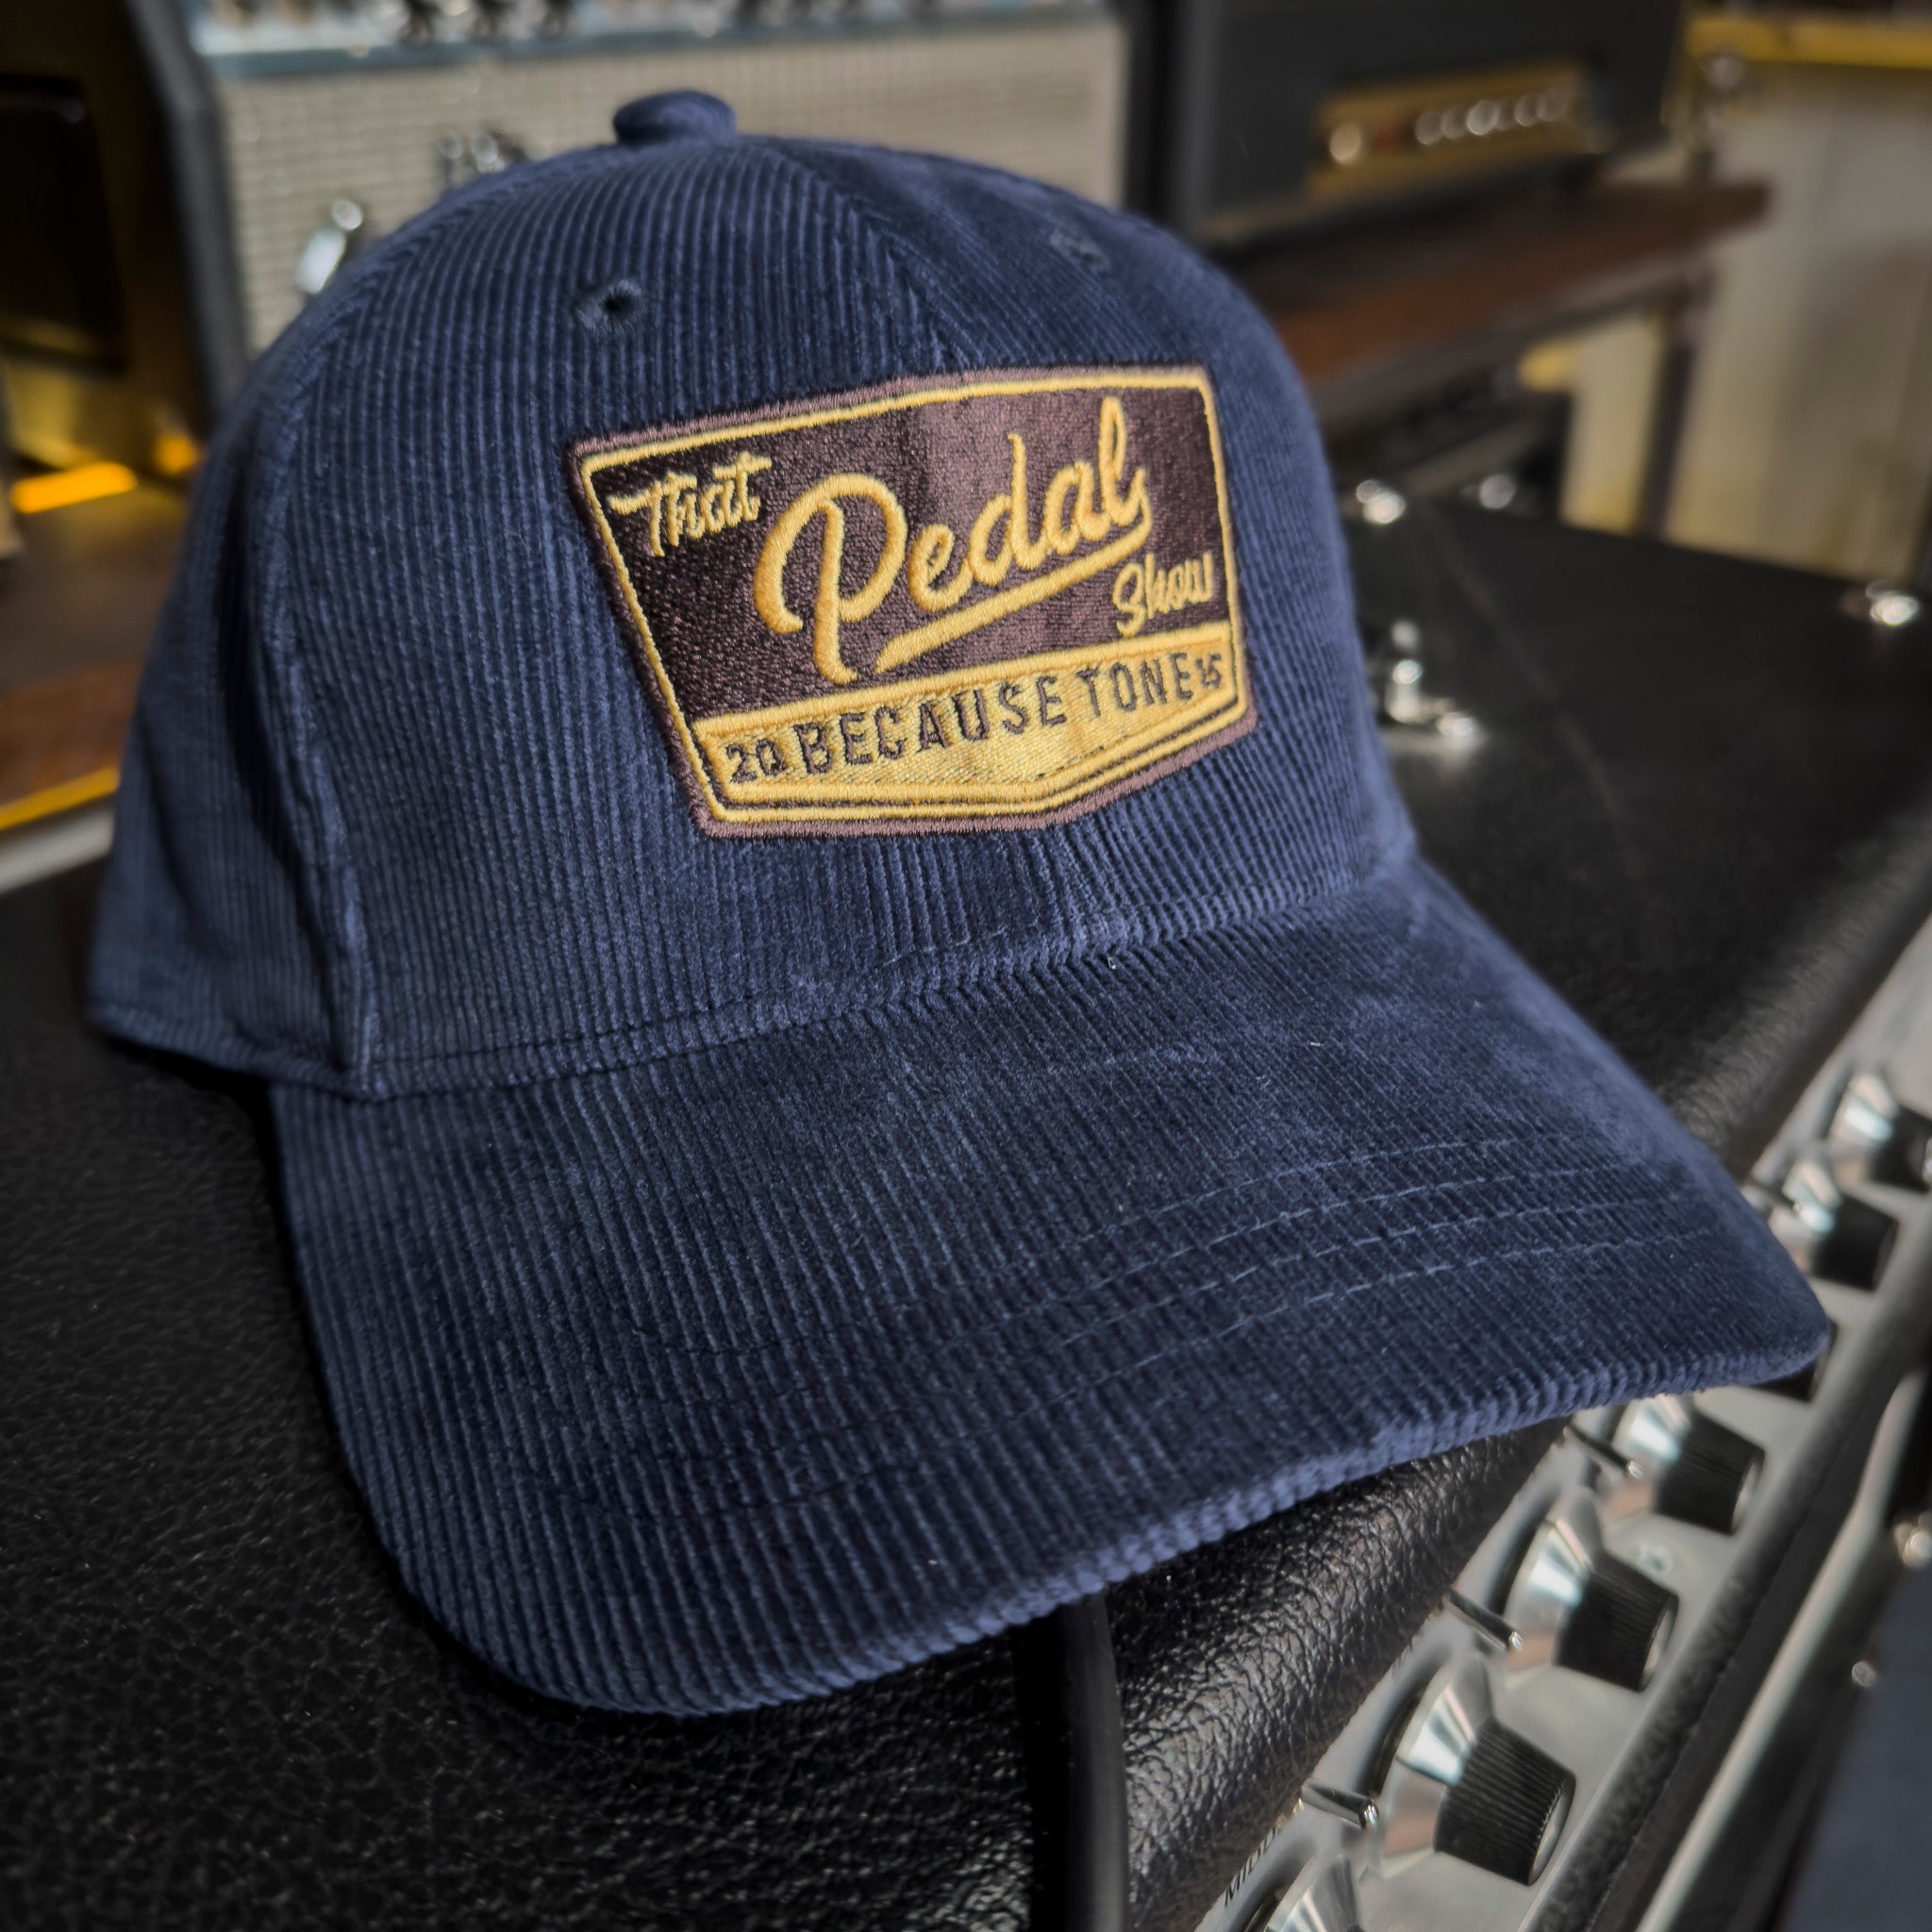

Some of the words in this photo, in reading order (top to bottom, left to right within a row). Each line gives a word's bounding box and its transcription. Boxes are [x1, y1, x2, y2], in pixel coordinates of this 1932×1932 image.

[607, 451, 772, 557] That
[755, 395, 1152, 685] Pedal
[1112, 550, 1214, 638] Show
[793, 675, 1067, 774] BECAUSE
[1076, 652, 1194, 719] TONE
